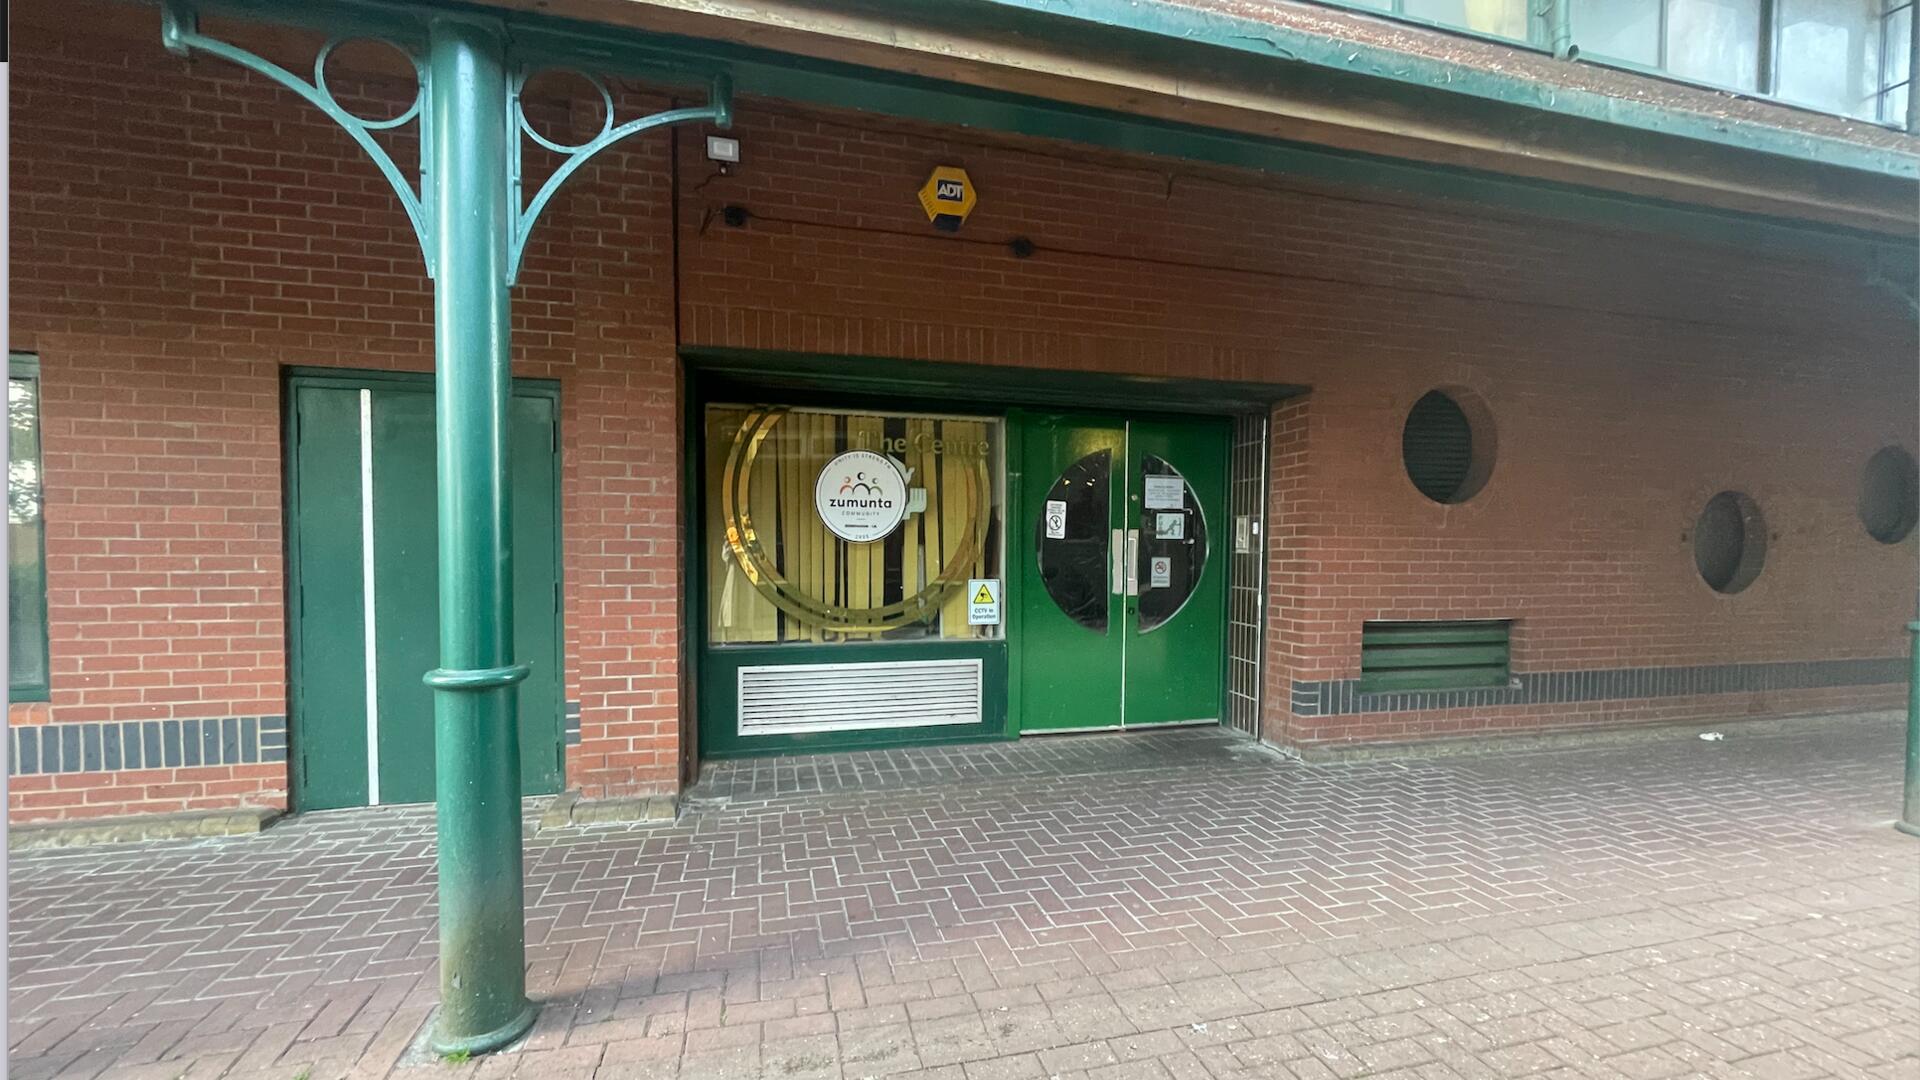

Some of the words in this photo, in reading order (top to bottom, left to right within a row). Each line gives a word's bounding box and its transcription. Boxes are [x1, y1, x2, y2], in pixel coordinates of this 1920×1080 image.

[938, 184, 964, 198] ADT
[914, 432, 989, 455] Centre
[829, 498, 893, 508] zumunta
